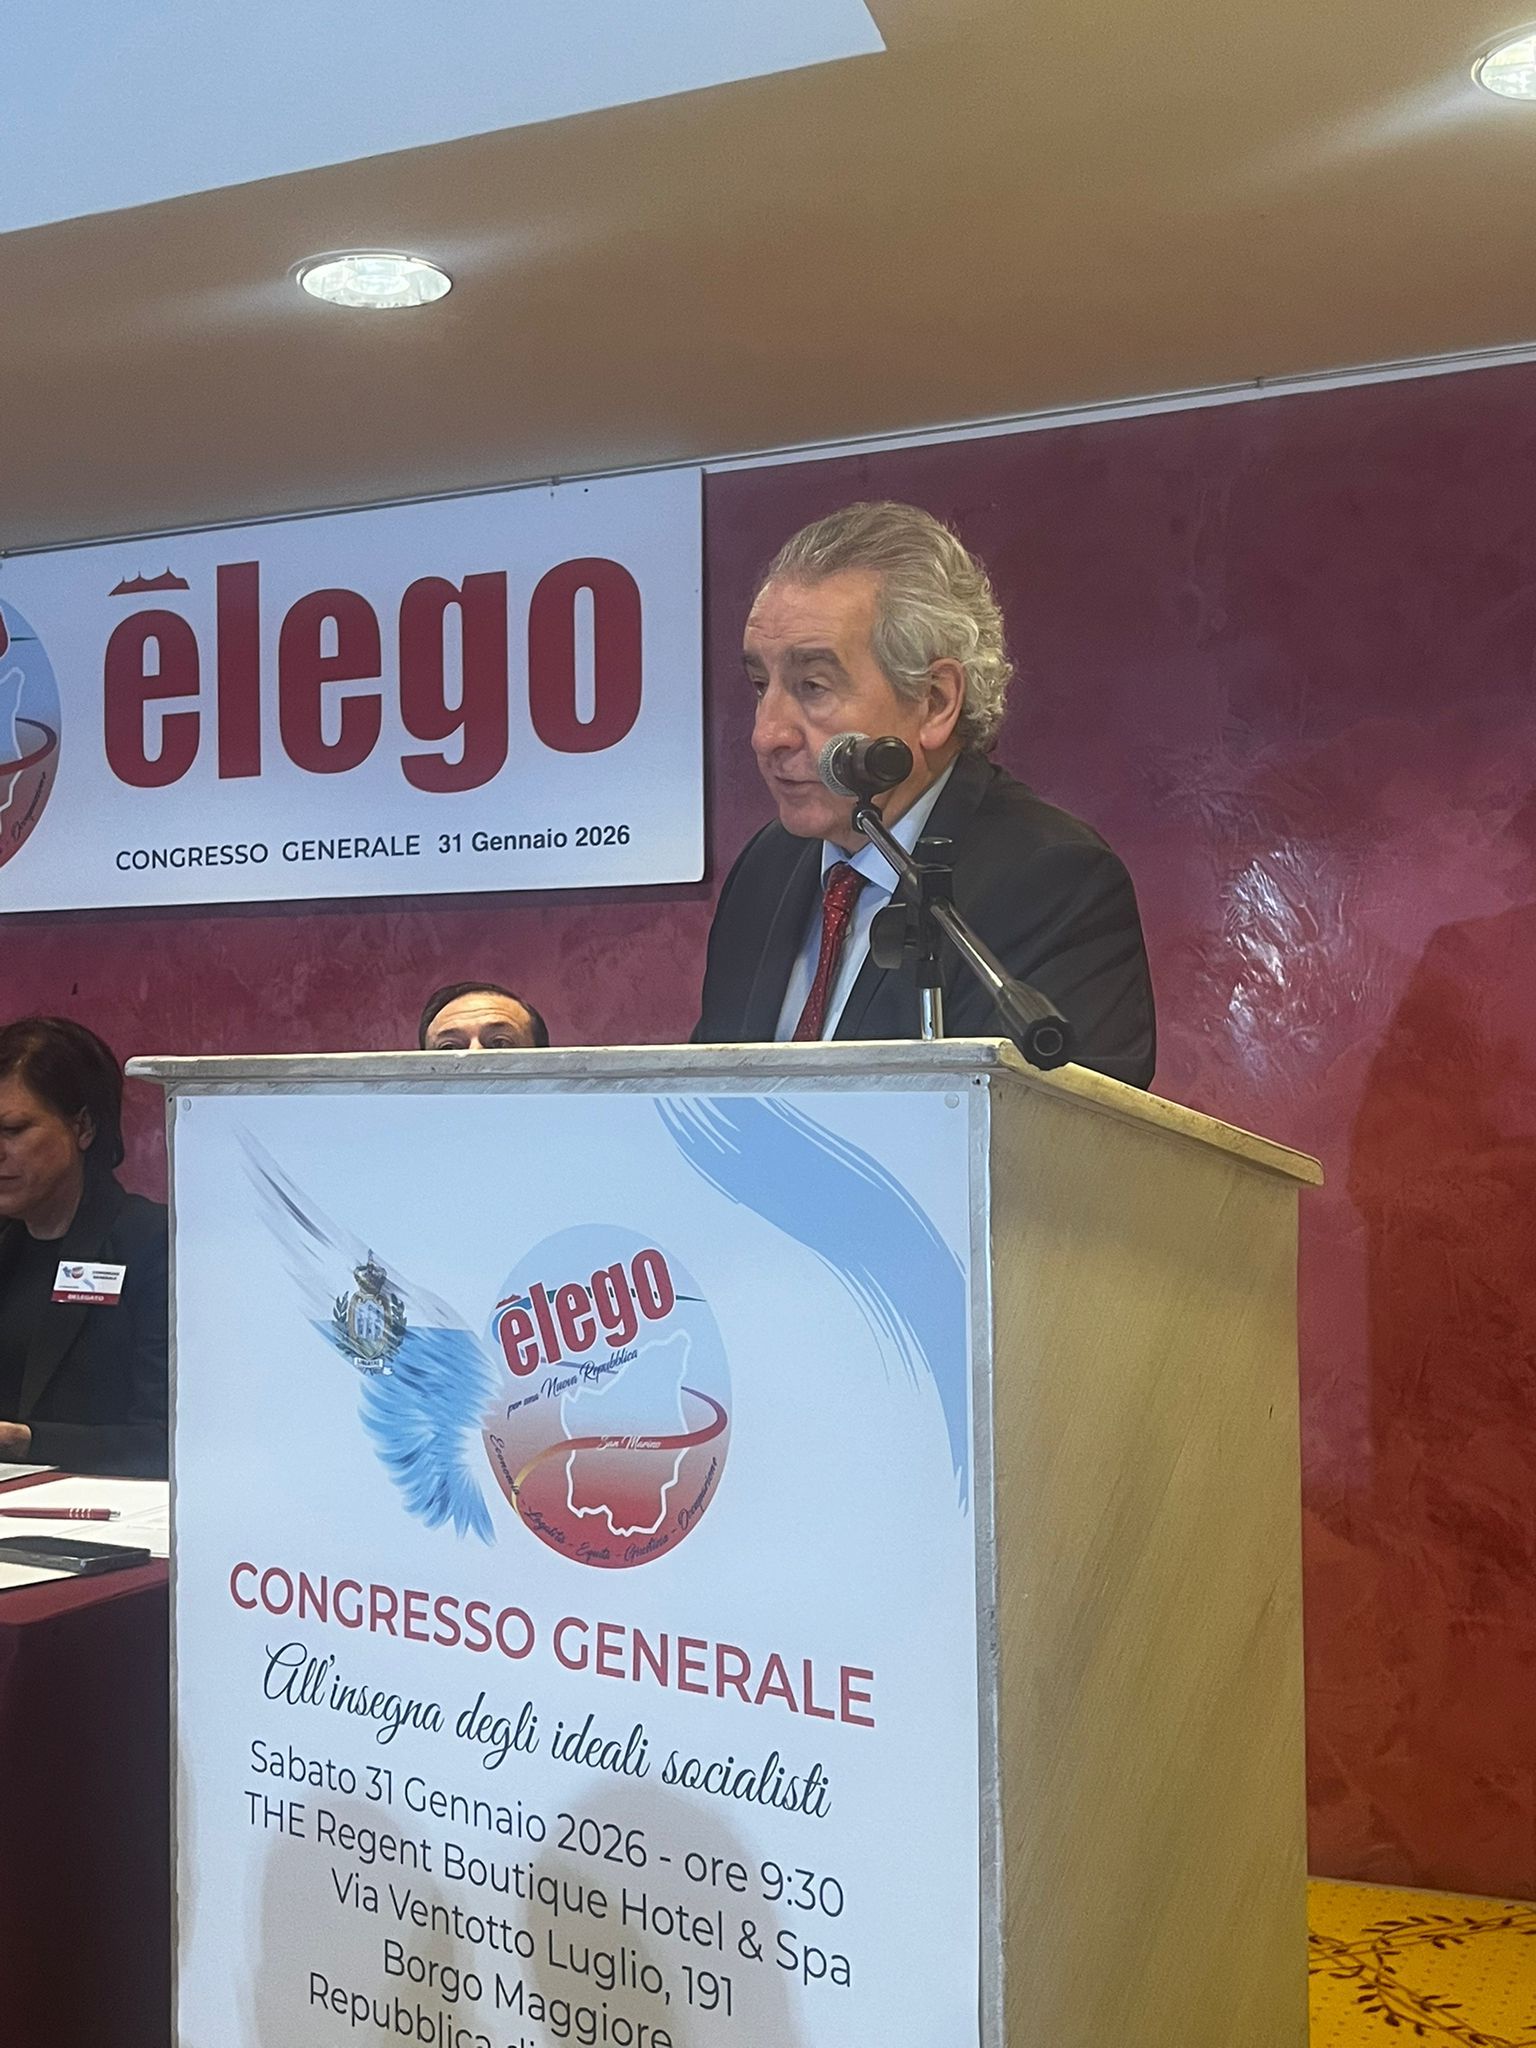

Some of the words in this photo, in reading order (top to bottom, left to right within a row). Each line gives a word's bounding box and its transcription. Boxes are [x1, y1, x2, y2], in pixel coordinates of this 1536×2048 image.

[115, 843, 269, 871] CONGRESSO
[282, 834, 421, 862] GENERALE
[438, 833, 462, 854] 31
[471, 828, 568, 852] Gennaio
[575, 824, 631, 847] 2026
[540, 1374, 579, 1399] Nuova
[579, 1347, 638, 1384] Repubblica
[489, 1433, 520, 1495] Economia
[596, 1434, 620, 1451] San
[620, 1434, 662, 1452] Marino
[229, 1561, 536, 1660] CONGRESSO
[552, 1615, 876, 1729] GENERALE
[263, 1641, 445, 1745] All'insegna
[455, 1691, 540, 1771] degli
[550, 1713, 651, 1778] ideali
[661, 1750, 832, 1819] socialisti
[244, 1790, 305, 1839] THE
[317, 1808, 433, 1873] Regent
[444, 1842, 608, 1919] Boutique
[622, 1887, 723, 1951] Hotel
[737, 1919, 764, 1963] &
[775, 1929, 851, 1988] Spa
[250, 1739, 356, 1794] Sabato
[365, 1765, 392, 1805] 31
[404, 1776, 546, 1843] Gennaio
[557, 1813, 647, 1868] 2026
[684, 1852, 748, 1892] ore
[760, 1861, 844, 1918] 9:30
[331, 1867, 379, 1914] Via
[388, 1883, 535, 1959] Ventotto
[548, 1929, 670, 2006] Luglio,
[681, 1964, 732, 2017] 191
[383, 1938, 483, 2003] Borgo
[495, 1973, 673, 2048] Maggiore
